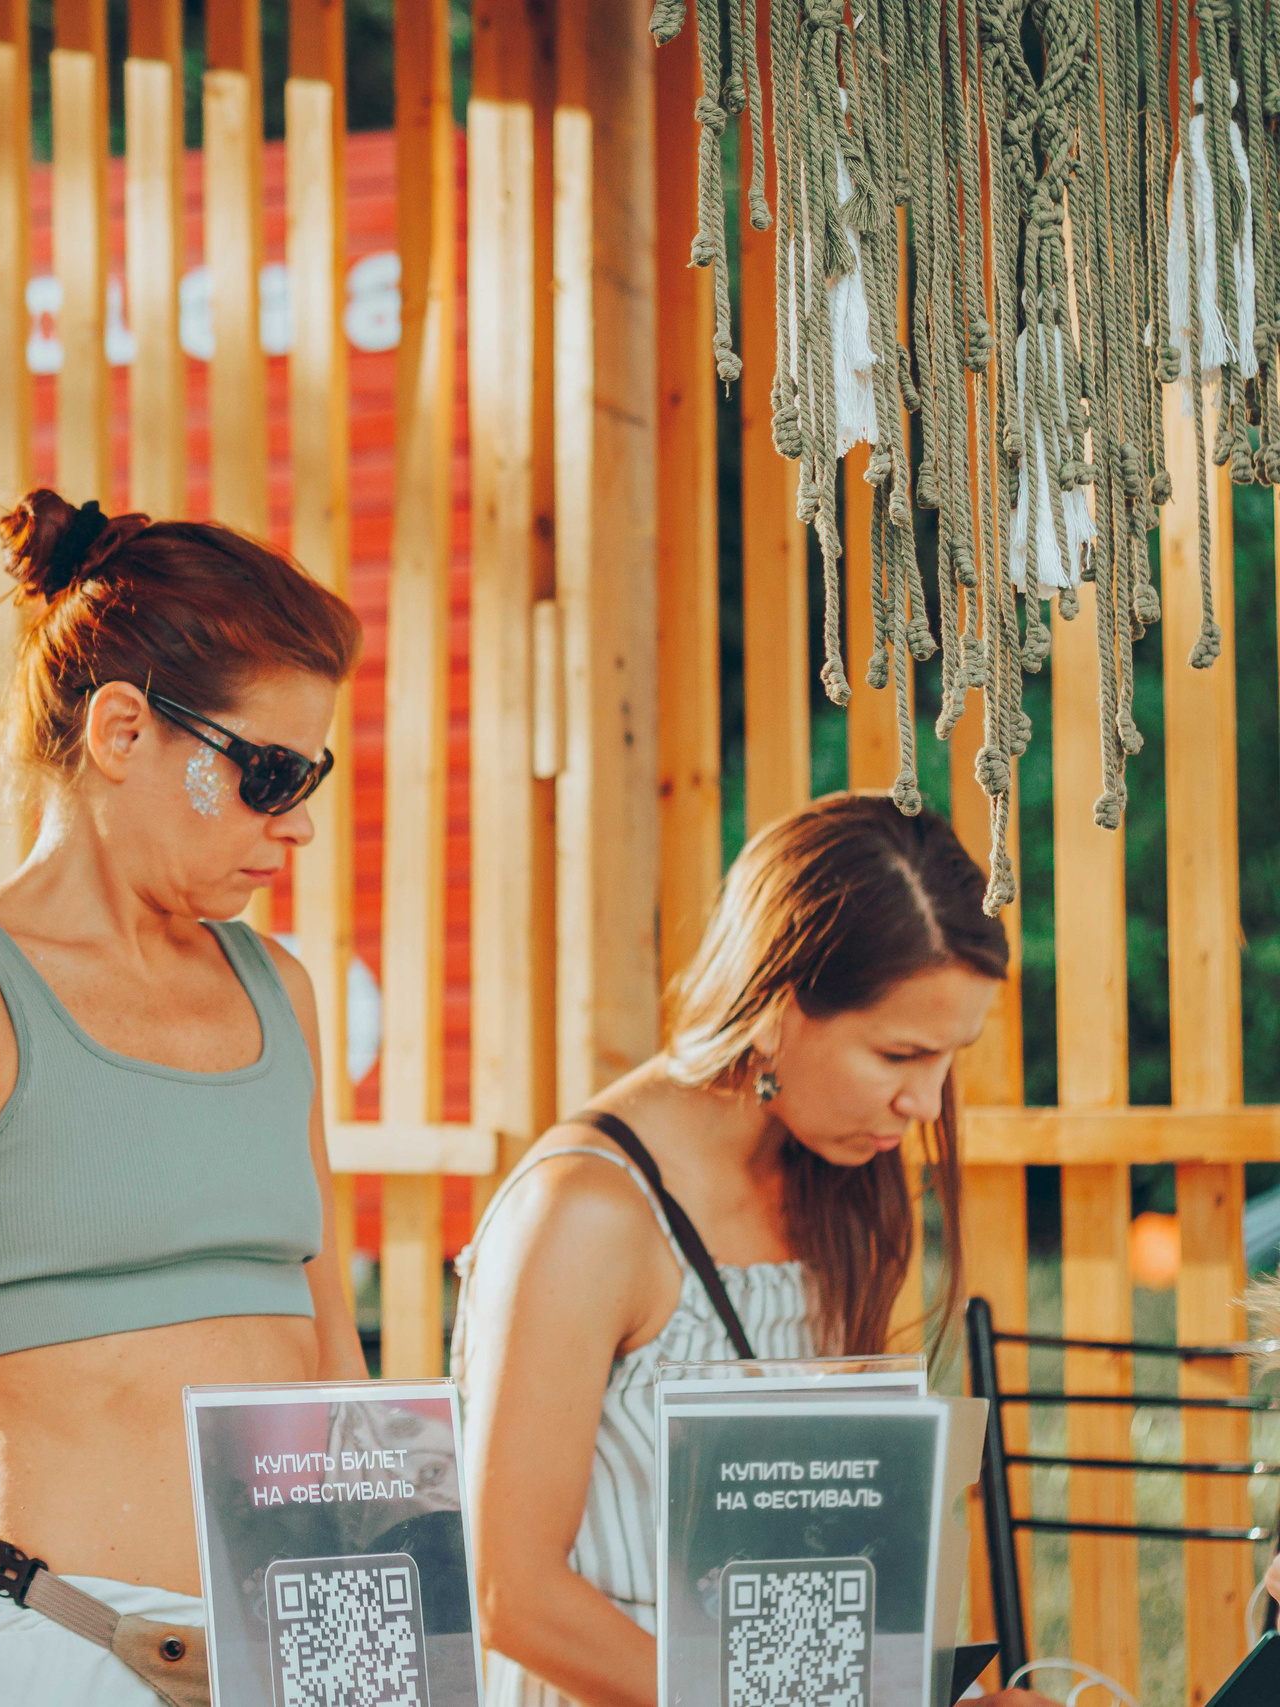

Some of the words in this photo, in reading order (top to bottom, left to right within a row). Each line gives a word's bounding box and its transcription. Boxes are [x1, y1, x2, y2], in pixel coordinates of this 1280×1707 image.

[255, 1452, 336, 1475] КУПИТЬ
[341, 1449, 408, 1471] БИЛЕТ
[721, 1461, 805, 1482] КУПИТЬ
[809, 1459, 880, 1480] БИЛЕТ
[253, 1485, 285, 1506] НА
[289, 1479, 415, 1504] ФЕСТИВАЛЬ
[716, 1491, 748, 1511] НА
[753, 1488, 883, 1510] ФЕСТИВАЛЬ
